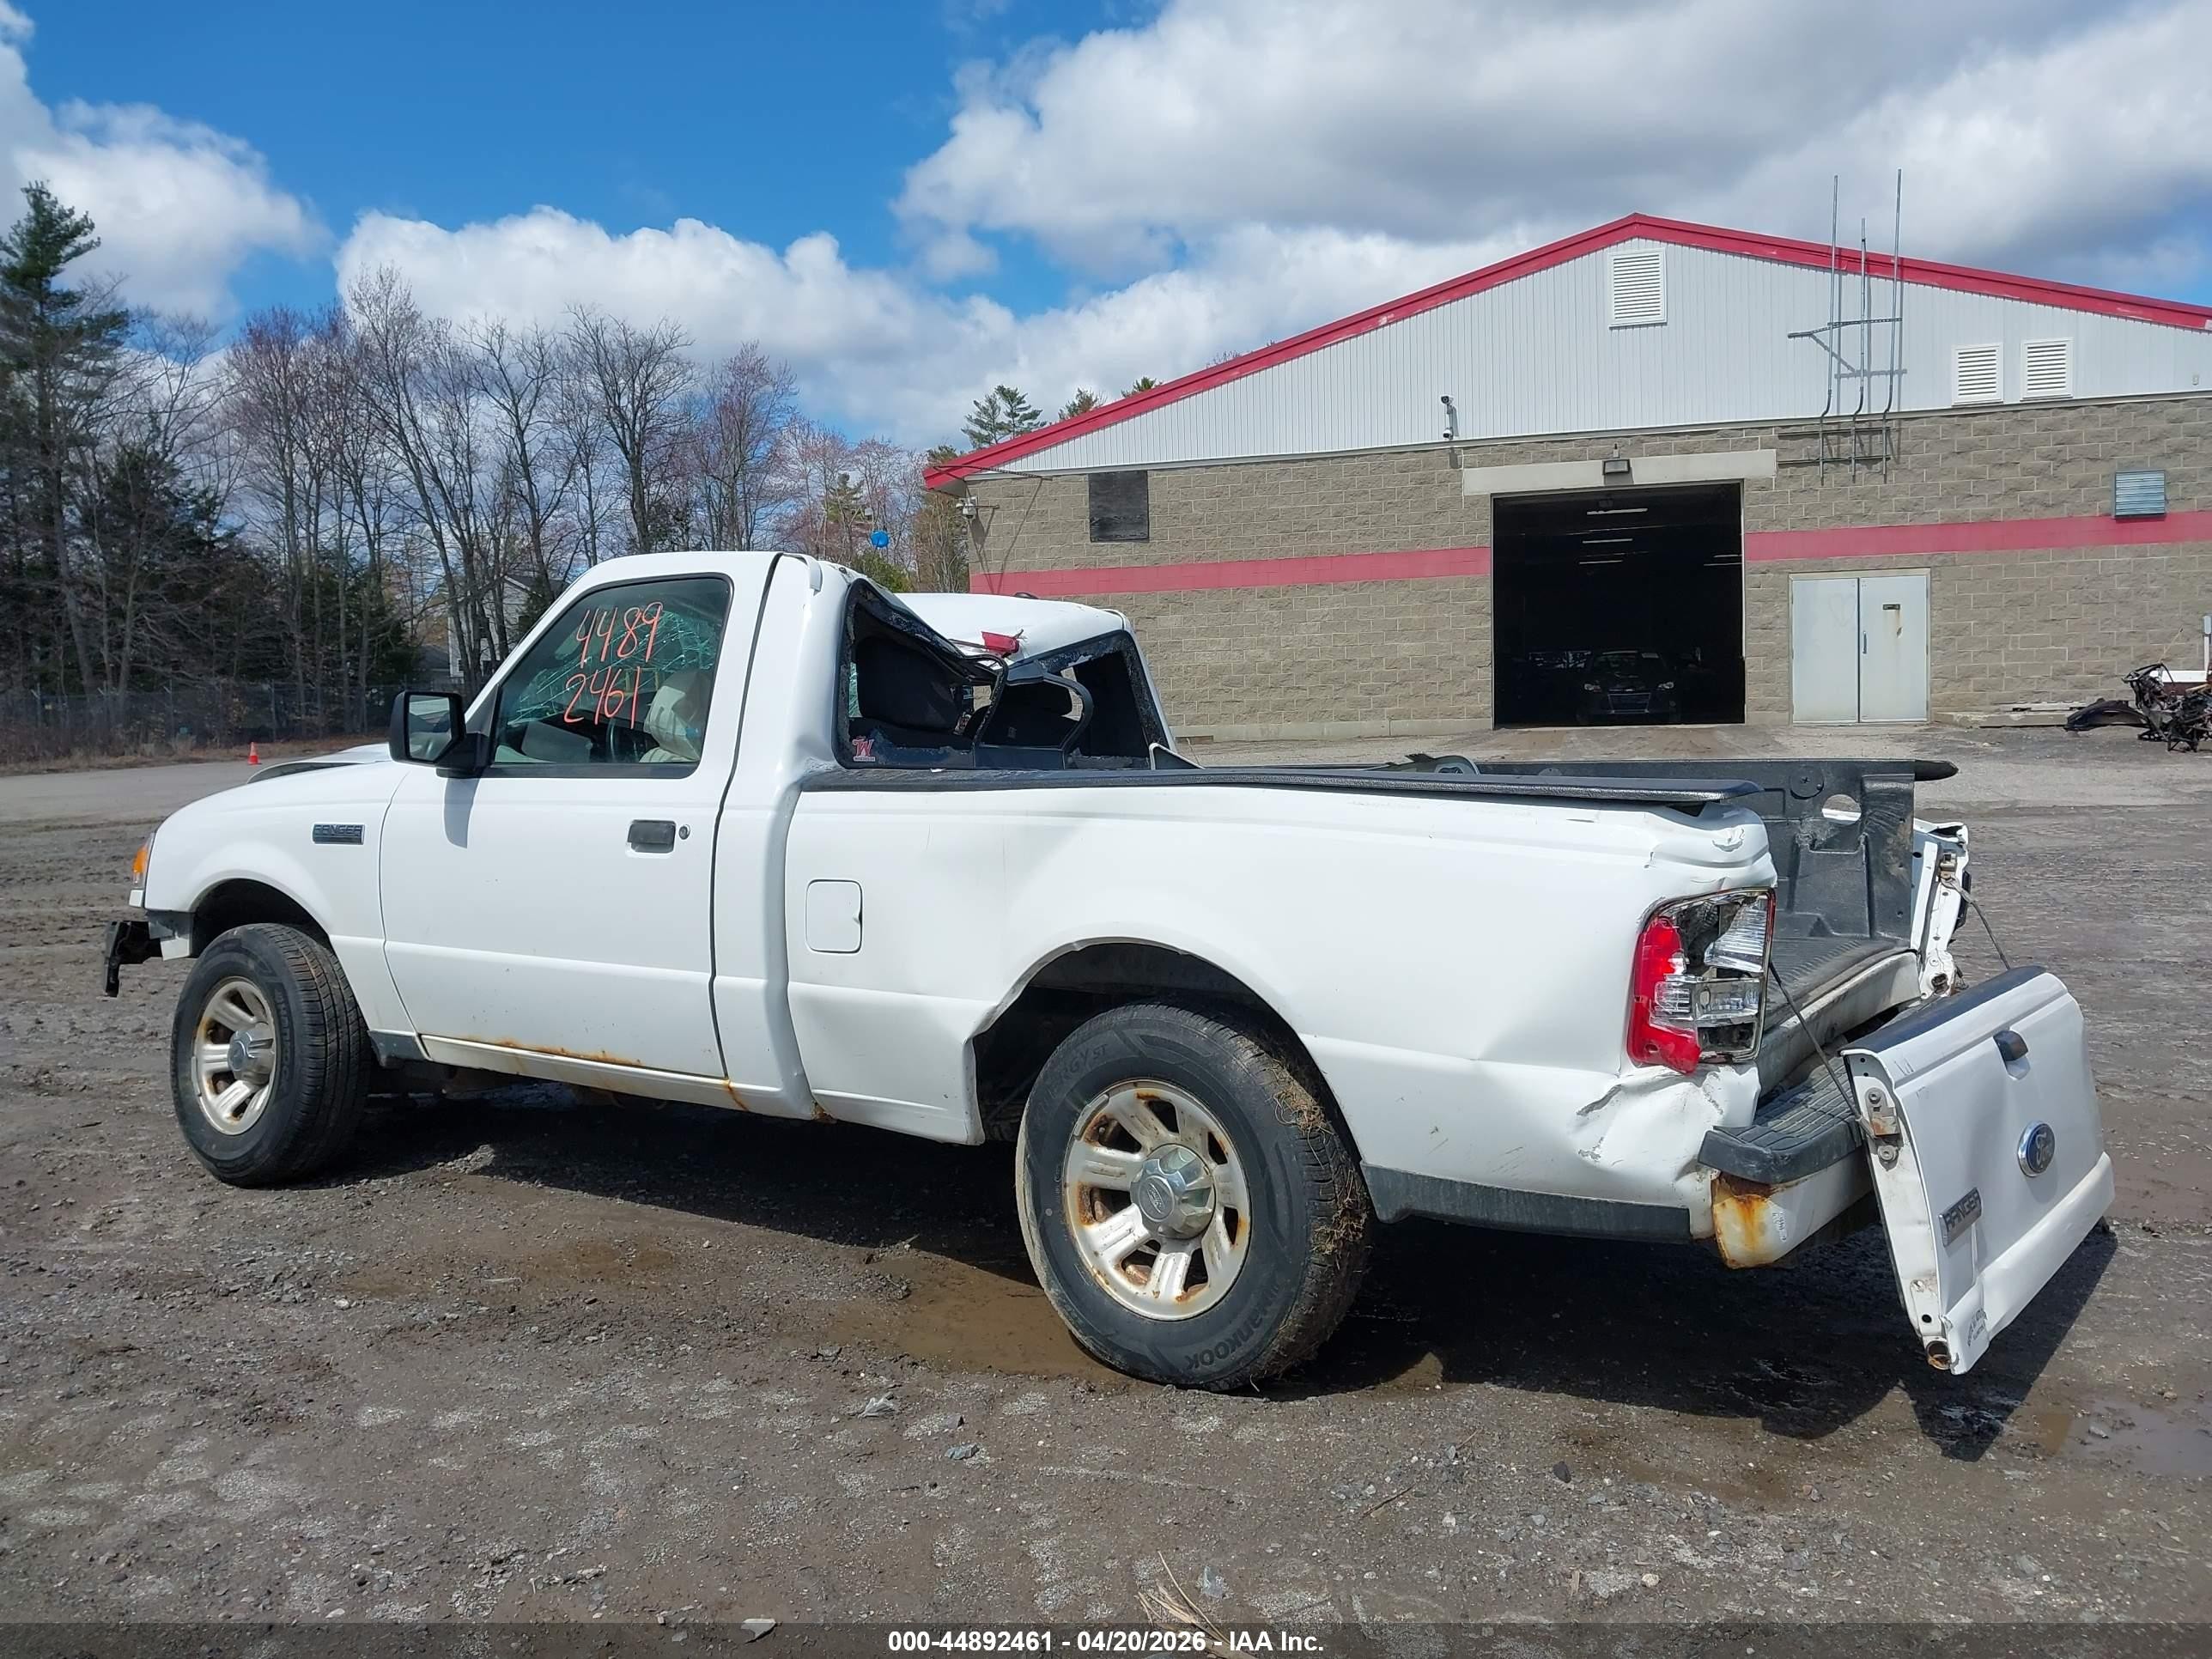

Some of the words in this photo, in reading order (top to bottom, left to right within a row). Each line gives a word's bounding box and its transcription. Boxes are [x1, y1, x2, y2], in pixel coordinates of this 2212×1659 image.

[575, 601, 664, 669] 4489
[563, 665, 641, 730] 2461
[313, 824, 362, 836] RANGER
[1942, 1190, 1979, 1233] RANGER
